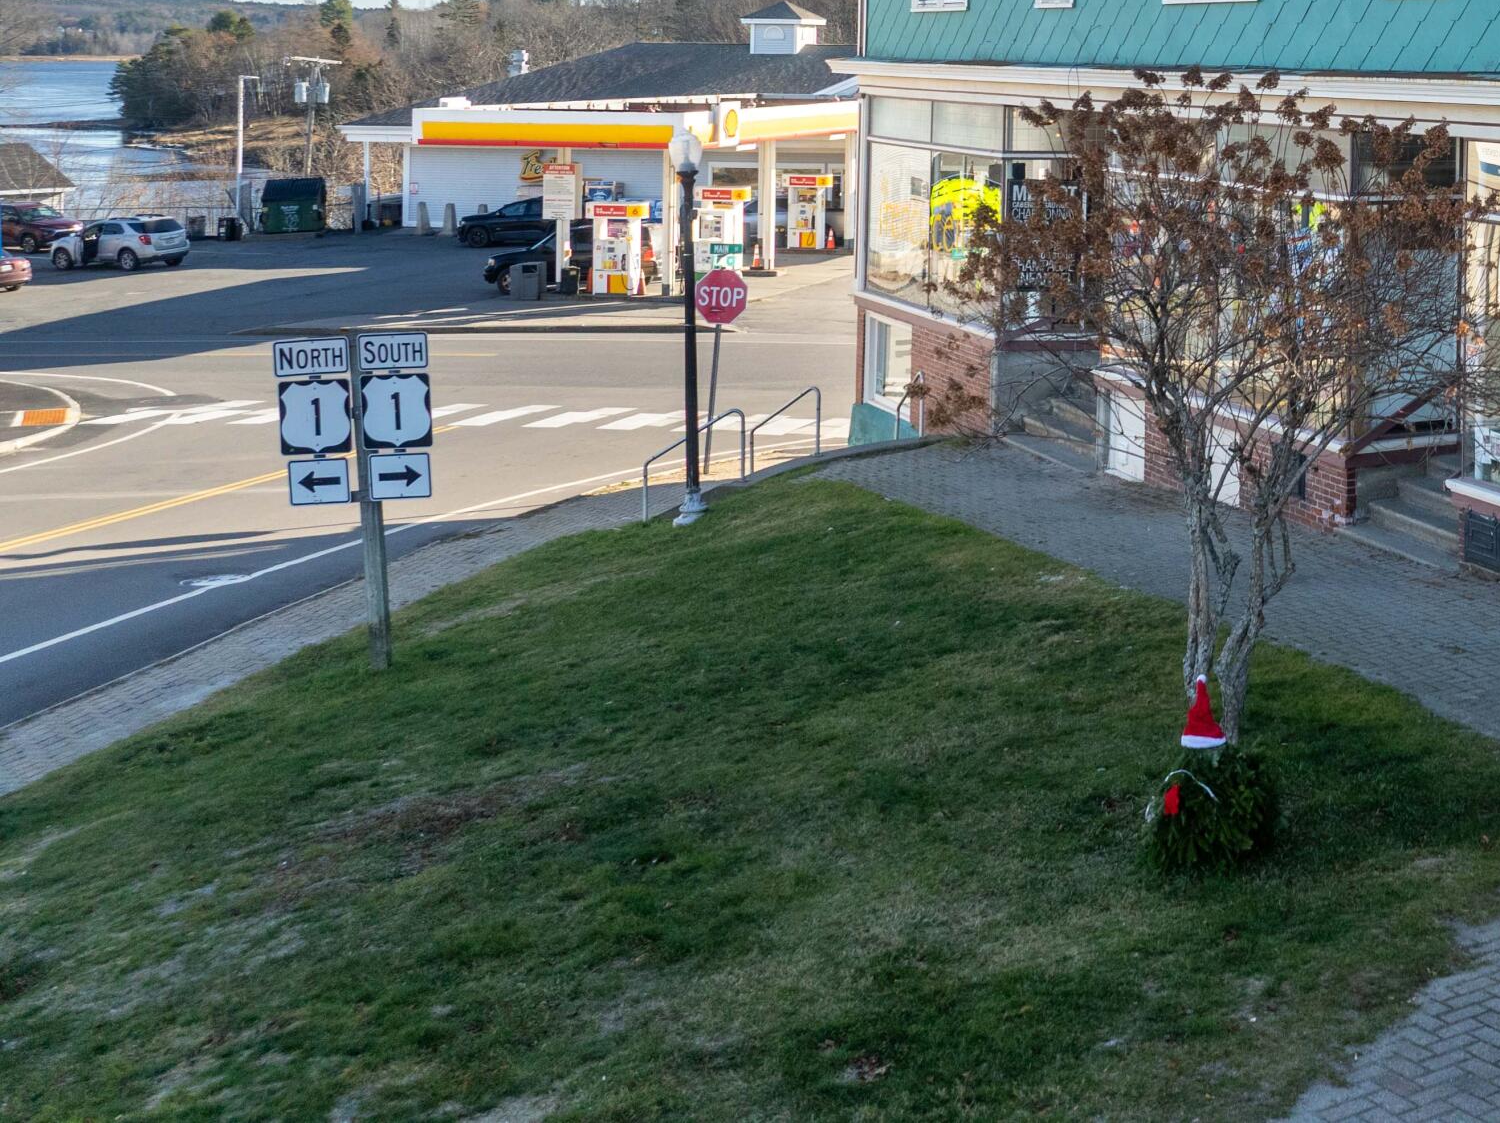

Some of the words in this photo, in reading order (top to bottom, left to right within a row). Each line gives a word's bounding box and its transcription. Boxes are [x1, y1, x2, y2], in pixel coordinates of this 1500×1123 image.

[713, 244, 729, 253] MAIN
[698, 285, 745, 308] STOP
[279, 347, 343, 370] NORTH
[363, 341, 423, 364] SOUTH
[311, 397, 321, 437] 1
[390, 391, 402, 431] 1
